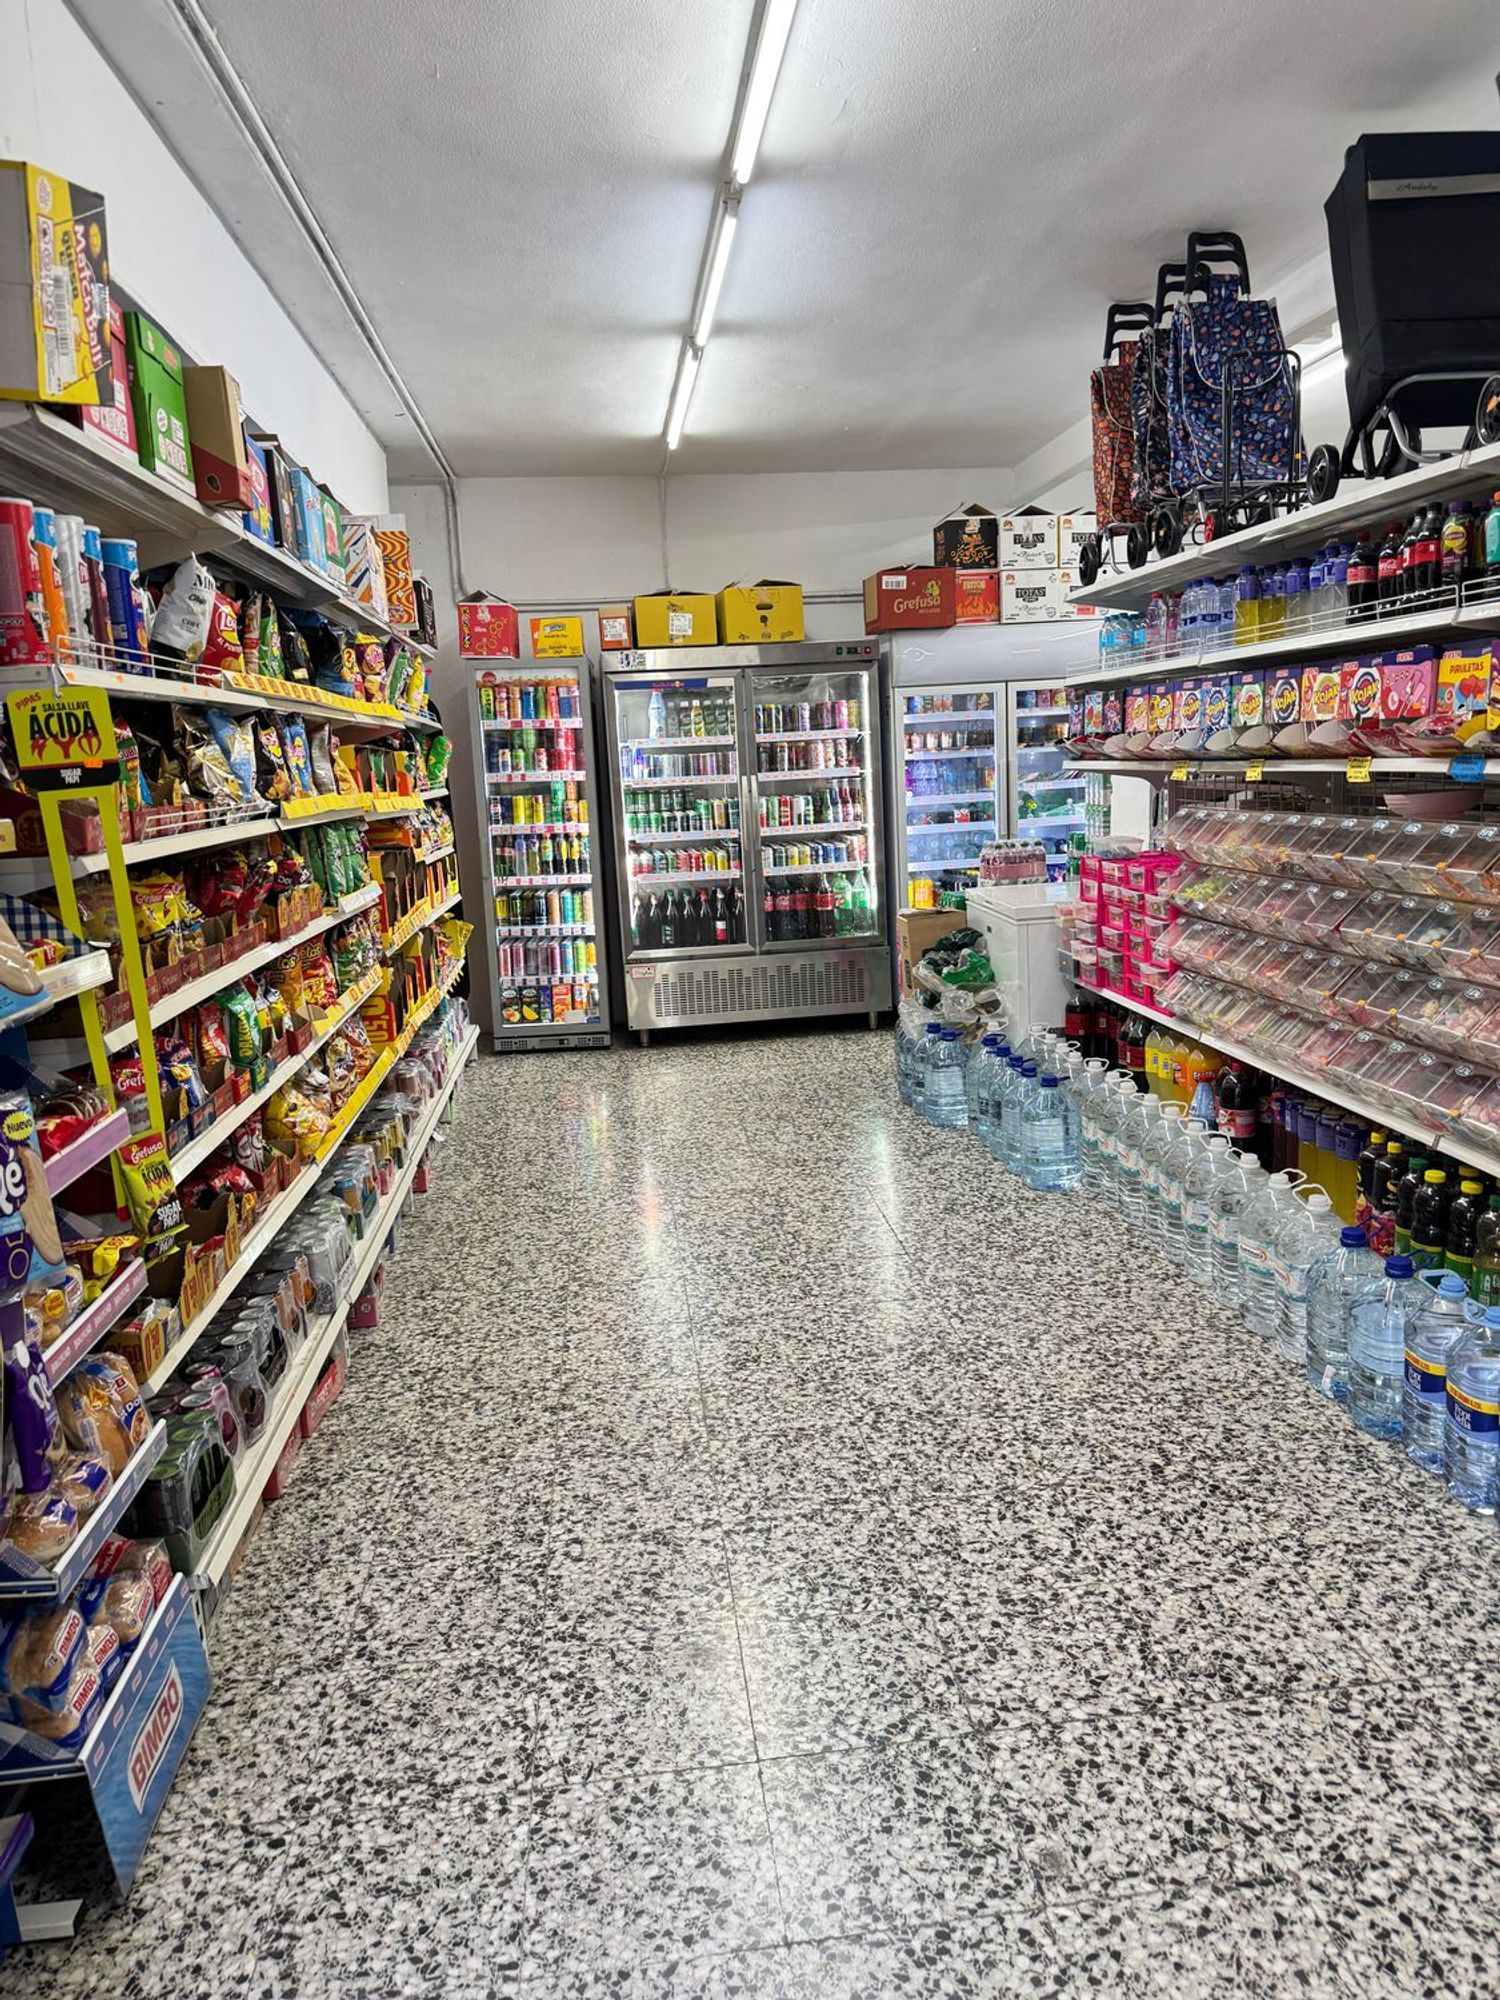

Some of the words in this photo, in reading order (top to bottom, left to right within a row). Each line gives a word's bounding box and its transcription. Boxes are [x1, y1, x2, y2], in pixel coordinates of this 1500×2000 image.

[893, 596, 940, 614] Grefusa
[1450, 661, 1484, 674] PIRULETAS
[14, 692, 42, 710] PIPAS
[1351, 679, 1379, 703] KOJAK
[42, 702, 67, 712] SALSA
[68, 701, 90, 711] LLAVE
[29, 706, 100, 740] ÁCIDA
[59, 1616, 81, 1657] BIMBO
[94, 1633, 118, 1665] BIMBO
[73, 1674, 97, 1713] BIMBO
[130, 1678, 180, 1795] BIMBO
